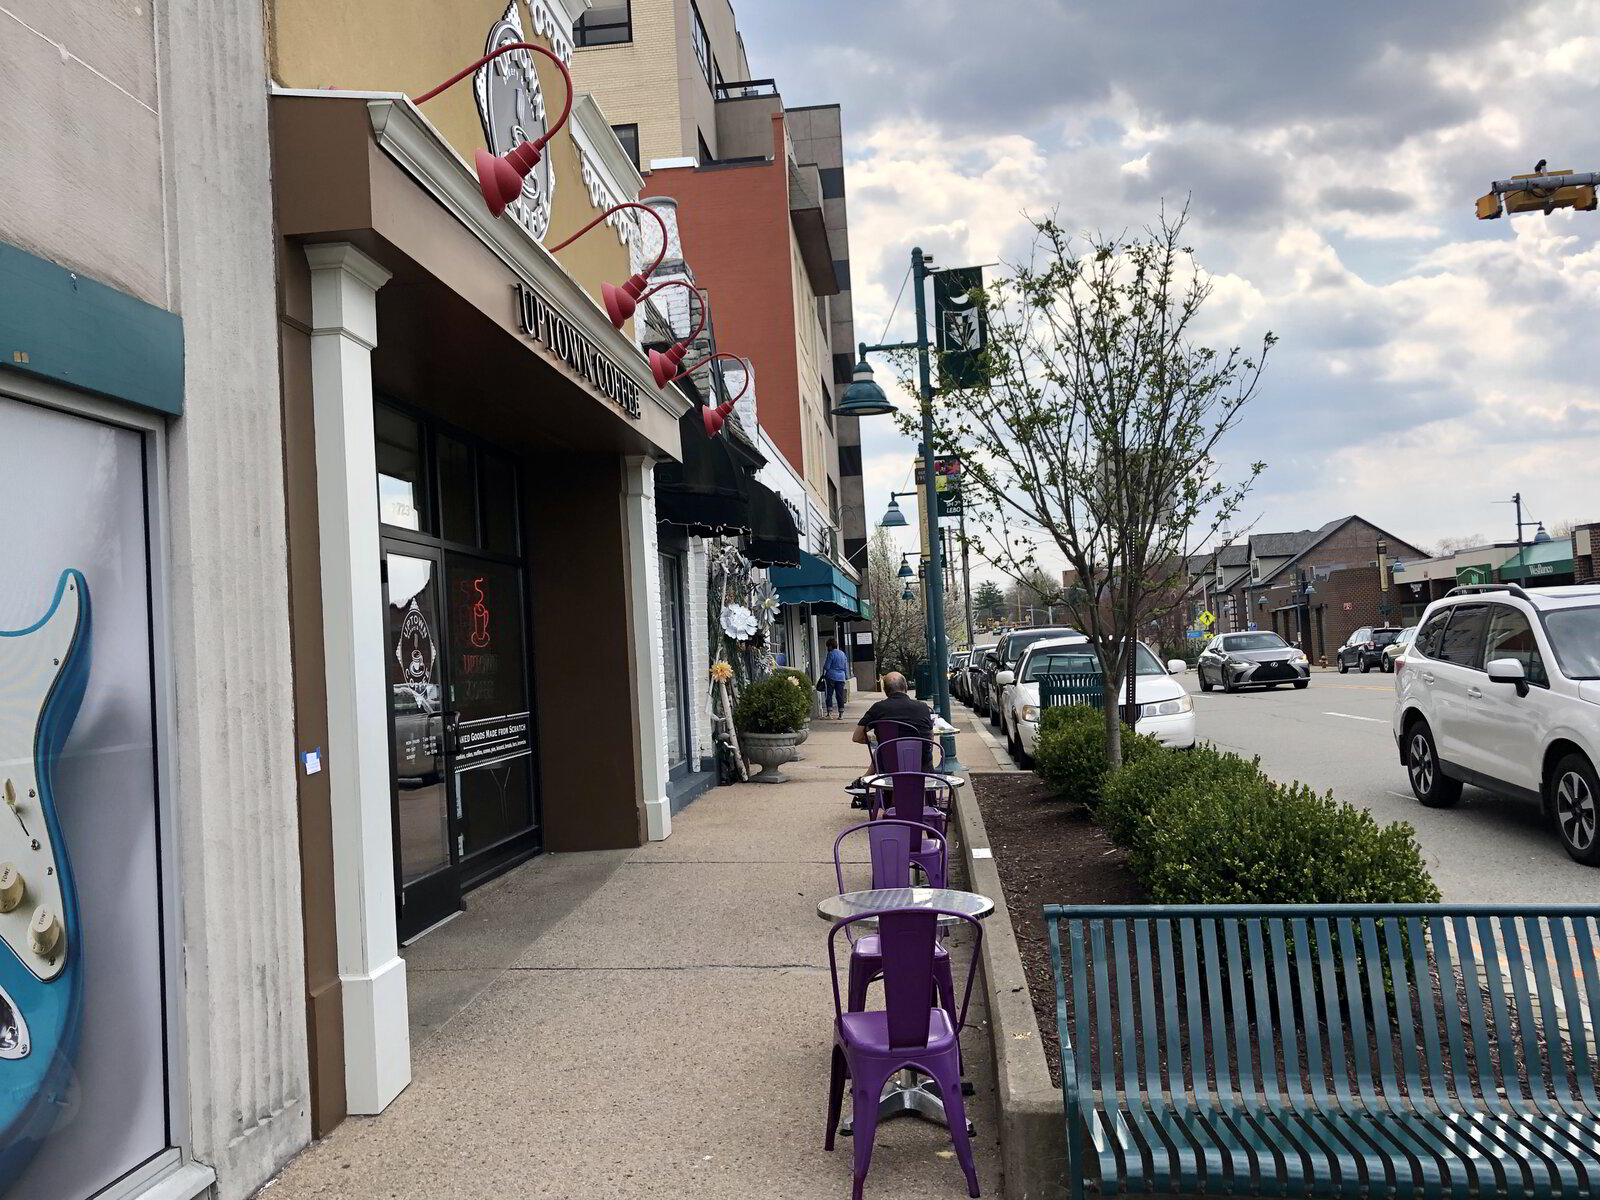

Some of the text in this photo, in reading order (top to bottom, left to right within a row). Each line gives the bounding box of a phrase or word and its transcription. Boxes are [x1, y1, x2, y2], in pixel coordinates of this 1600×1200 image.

[515, 283, 641, 419] UPTOWN COFFEE
[946, 506, 961, 514] LEBO
[404, 615, 427, 638] UPTOWN
